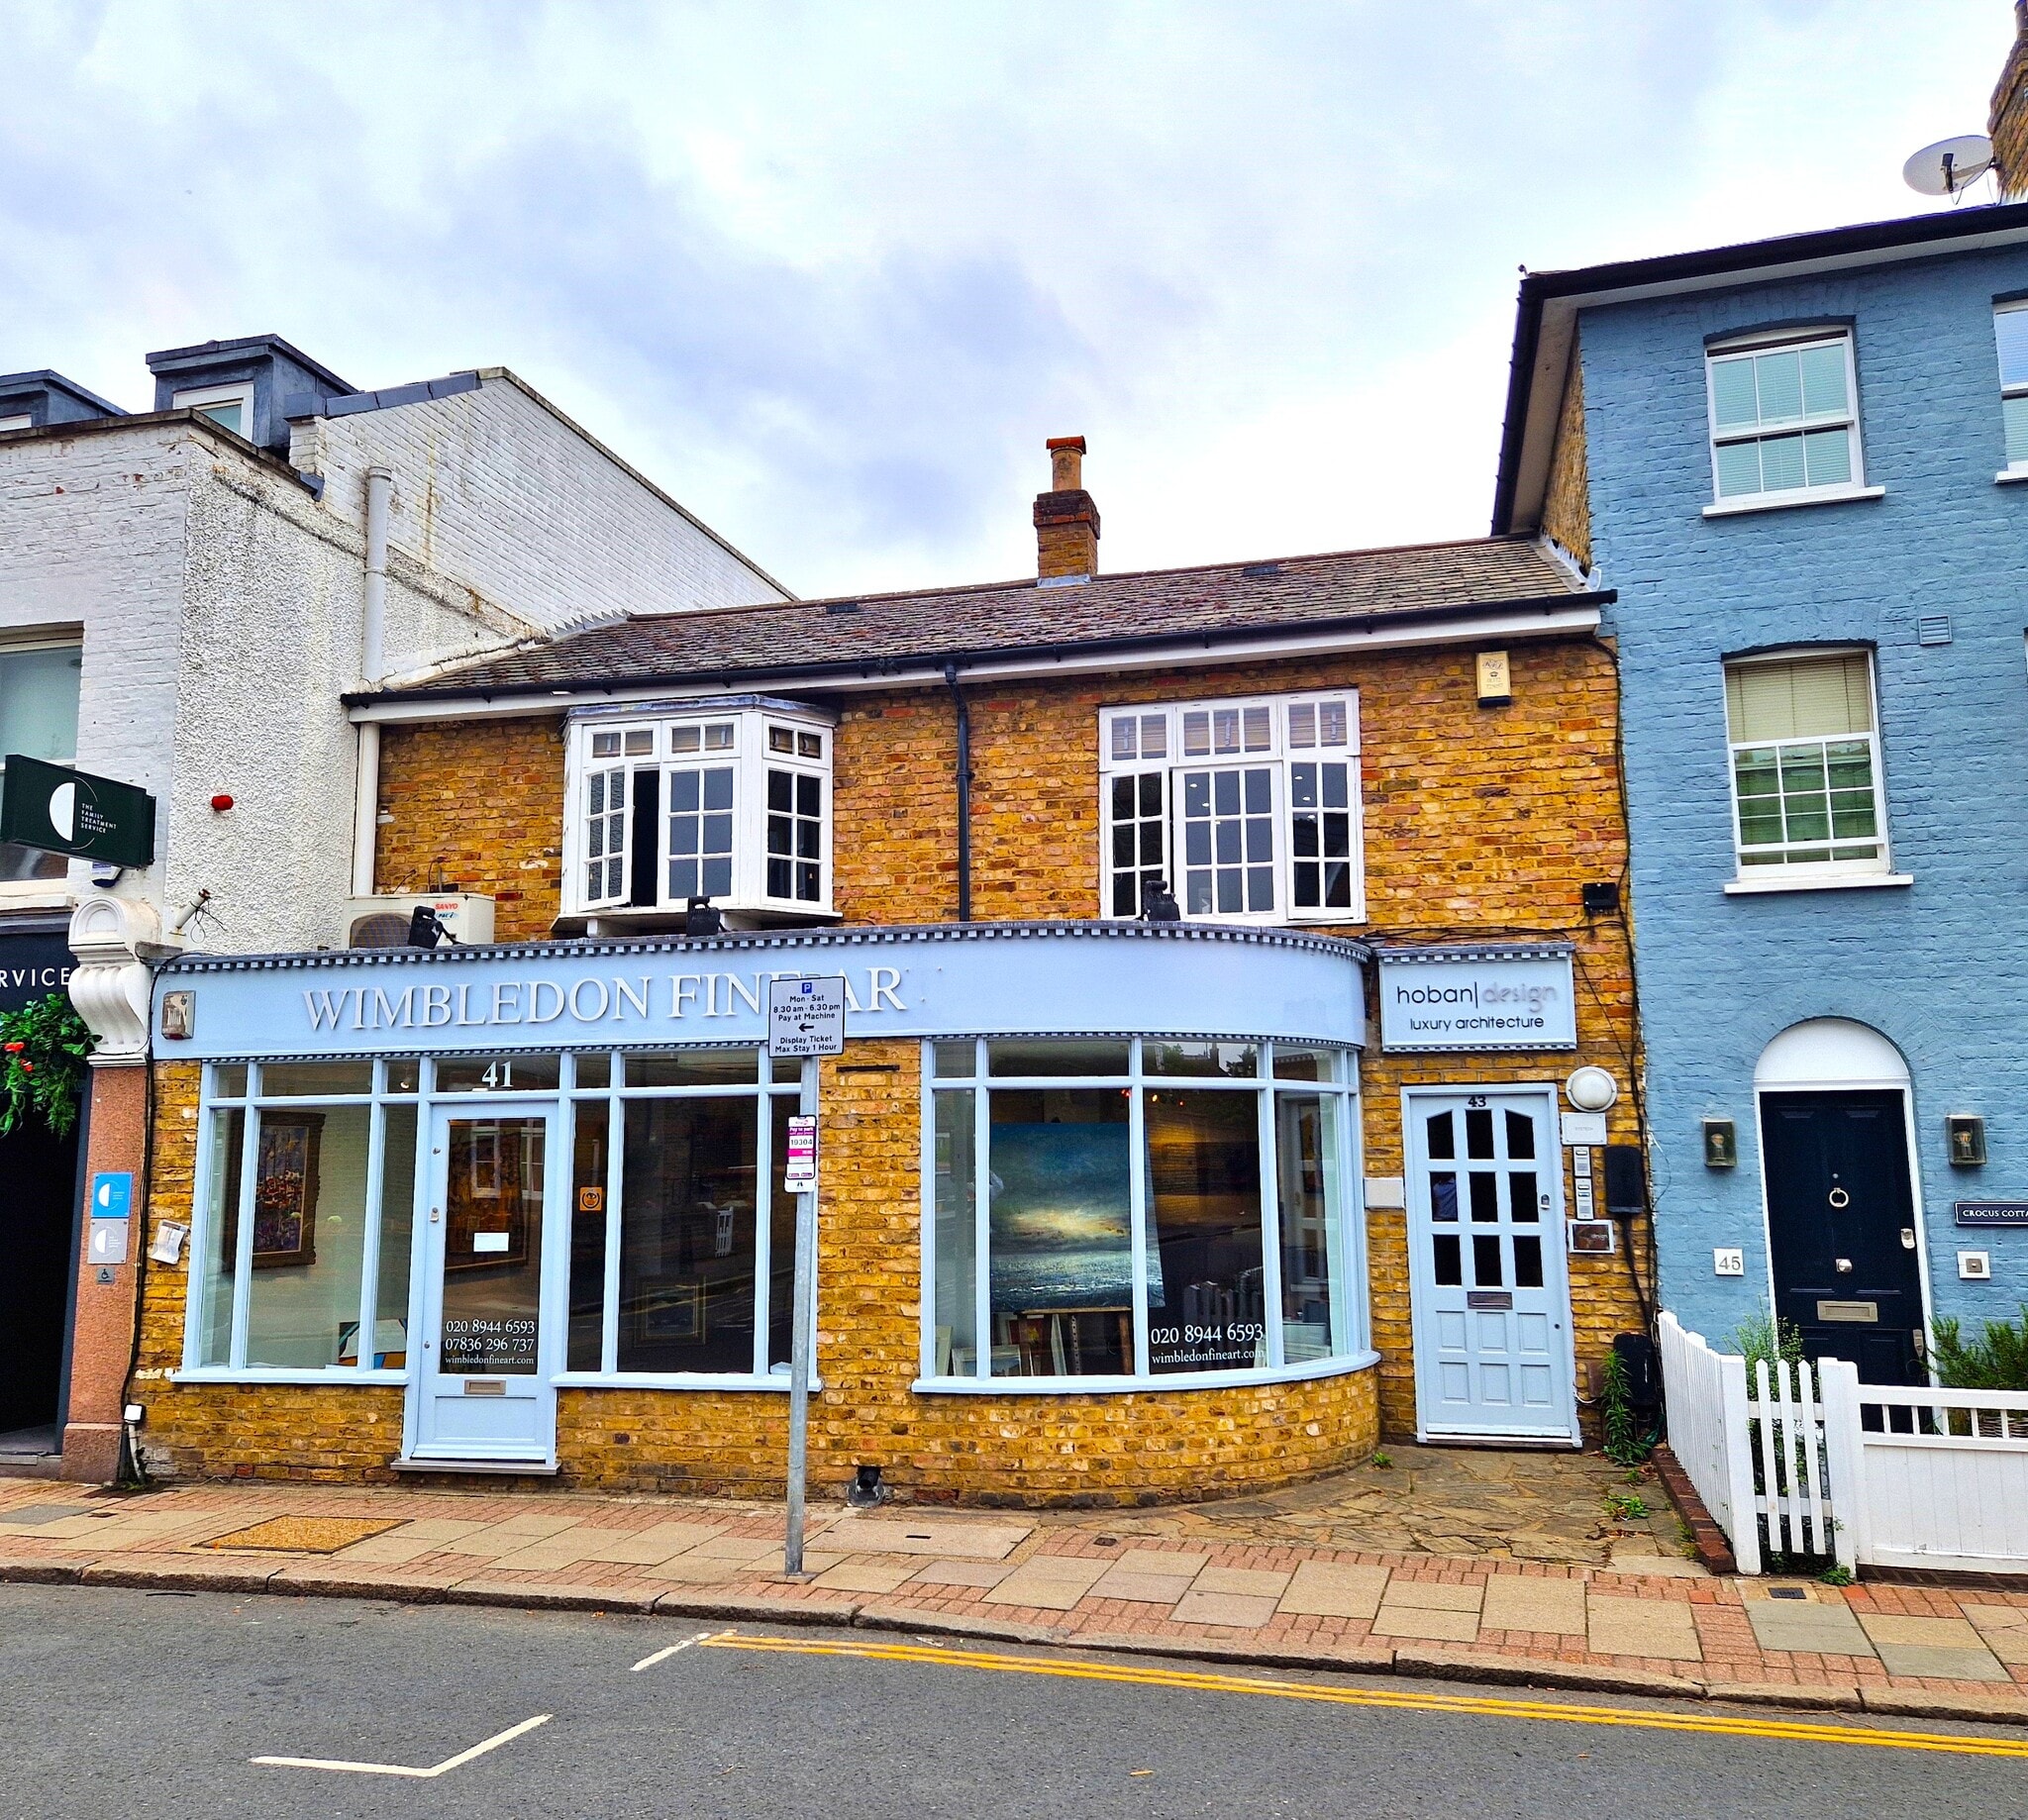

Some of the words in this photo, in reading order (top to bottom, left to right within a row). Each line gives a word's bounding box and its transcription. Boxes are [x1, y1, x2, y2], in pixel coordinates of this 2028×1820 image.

[81, 810, 104, 820] FAMILY
[81, 816, 117, 830] TREATMENT
[80, 823, 106, 834] SERVICE
[302, 975, 653, 1031] WIMBLEDON
[667, 970, 801, 1019] FIN
[1409, 1017, 1452, 1032] luxury
[1456, 1015, 1545, 1030] architecture
[481, 1061, 514, 1088] 41
[1468, 1095, 1487, 1108] 43
[1718, 1256, 1741, 1270] 45
[446, 1320, 468, 1333] 020
[471, 1318, 502, 1334] 8944
[505, 1318, 535, 1334] 6593
[1151, 1327, 1179, 1345] 020
[1184, 1324, 1222, 1344] 8944
[1227, 1322, 1264, 1342] 6593
[445, 1336, 482, 1352] 07836
[485, 1337, 508, 1352] 296
[512, 1338, 535, 1352] 737
[445, 1354, 535, 1365] wimbledonfineart.com
[1152, 1348, 1266, 1365] wimbledonfineart.com
